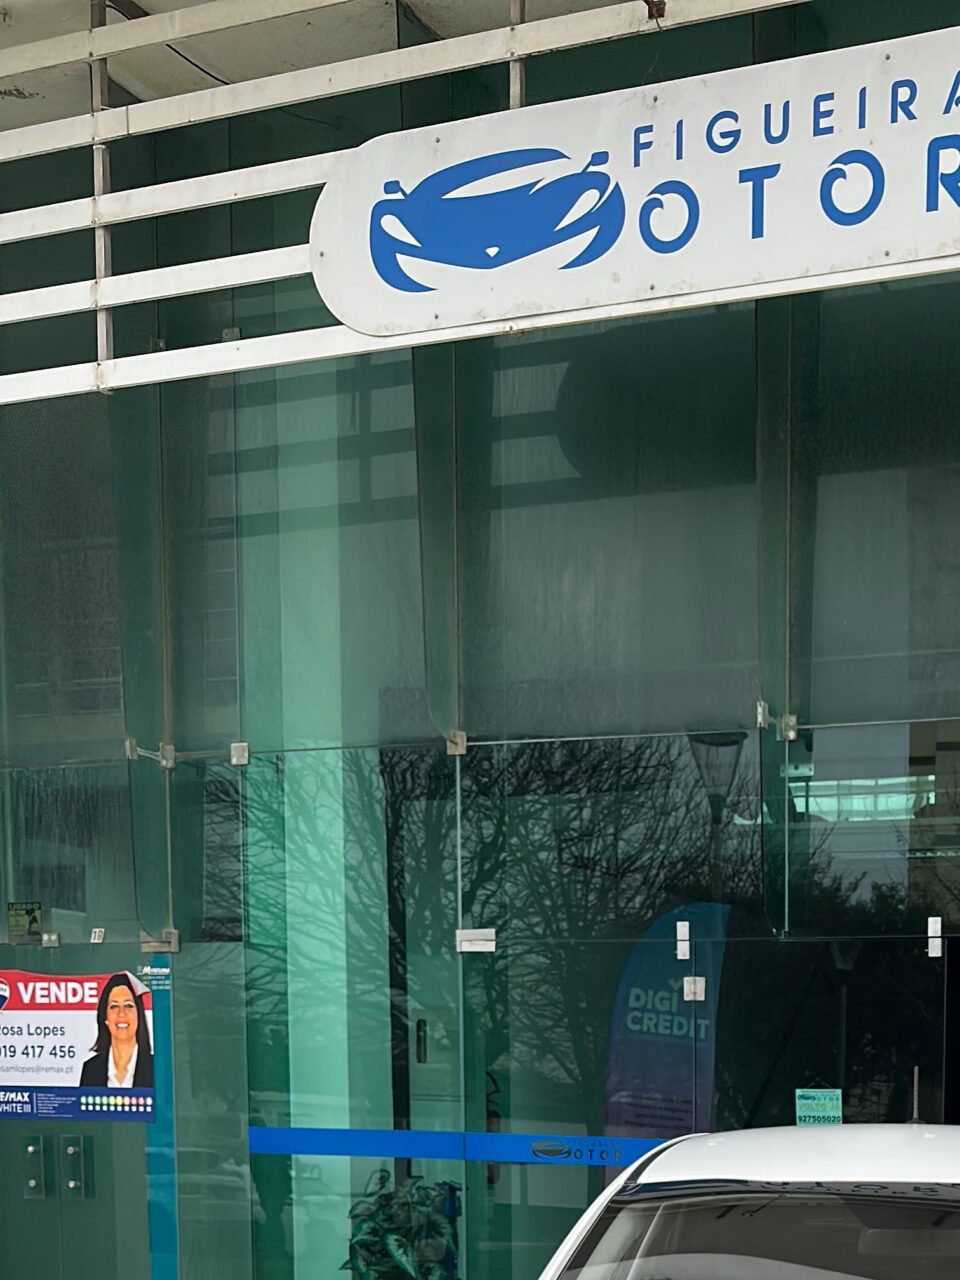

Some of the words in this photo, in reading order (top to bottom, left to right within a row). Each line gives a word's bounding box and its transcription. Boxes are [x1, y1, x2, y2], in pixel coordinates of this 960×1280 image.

[17, 981, 99, 1004] VENDE
[628, 987, 679, 1013] DIGI
[27, 1024, 66, 1039] Lopes
[626, 1010, 711, 1040] CREDIT
[0, 1045, 17, 1058] 19
[21, 1045, 44, 1058] 417
[49, 1046, 76, 1059] 456
[798, 1115, 842, 1123] 927505020
